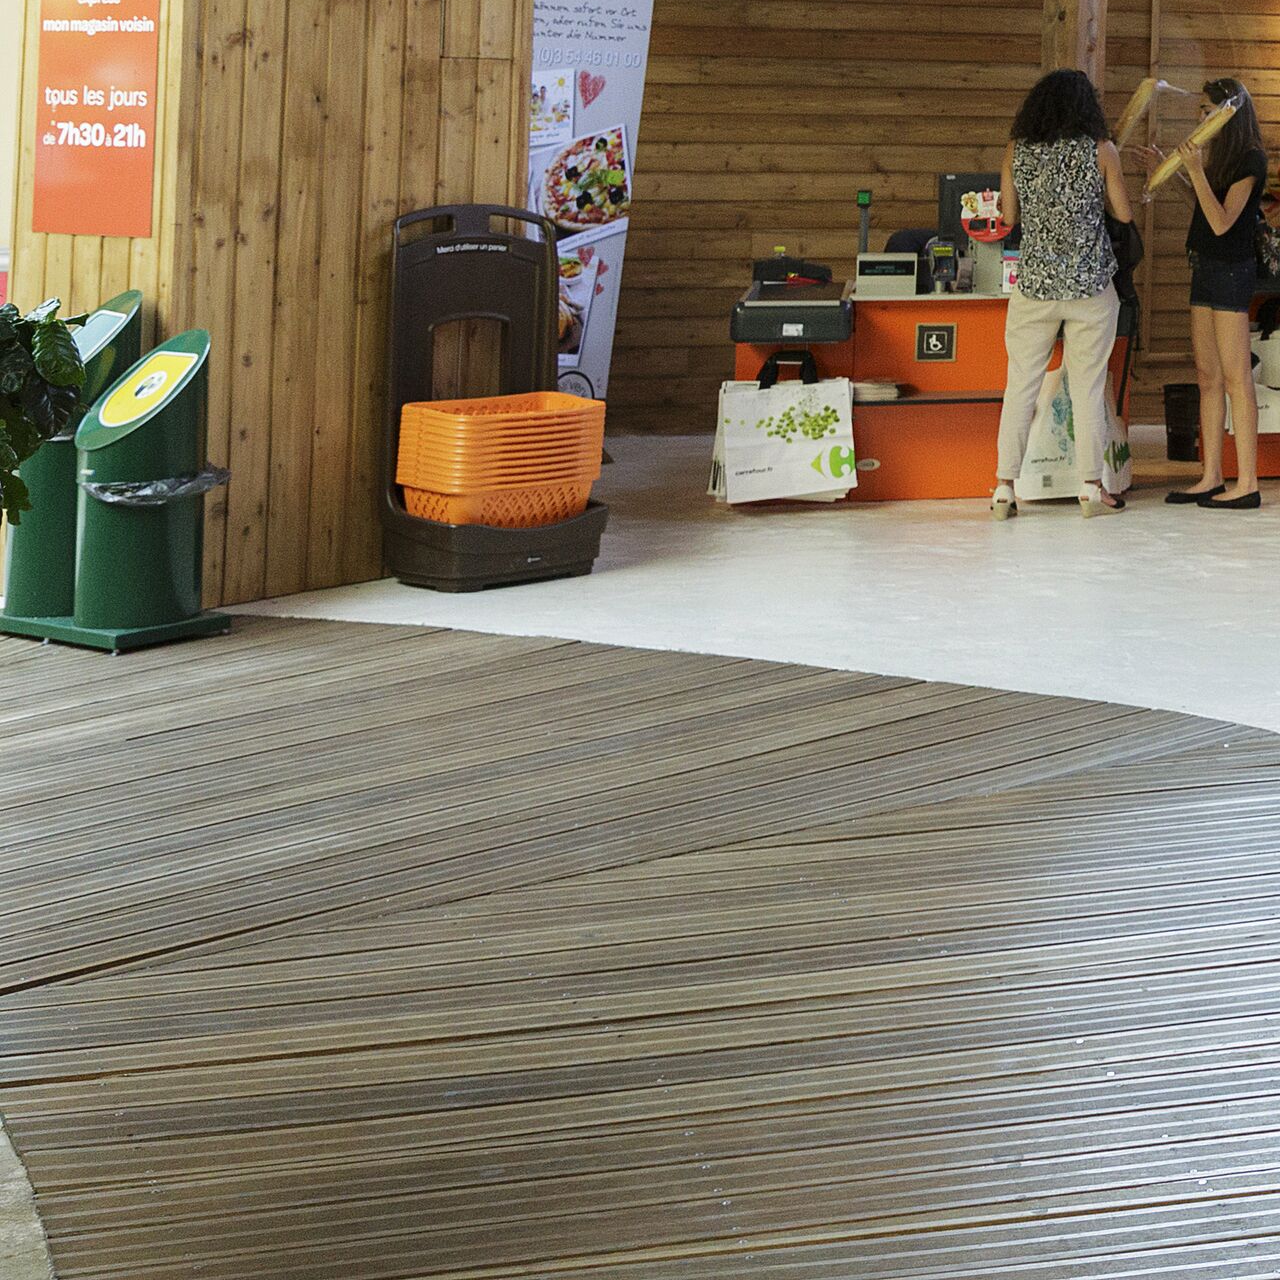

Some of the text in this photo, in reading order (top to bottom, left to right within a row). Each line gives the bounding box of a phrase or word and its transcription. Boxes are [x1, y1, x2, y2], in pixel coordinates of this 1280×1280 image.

[43, 16, 154, 35] mon magasin voisin
[45, 85, 148, 110] tous les jours
[43, 132, 56, 145] de
[57, 122, 105, 147] 7h30
[113, 122, 146, 147] 21h
